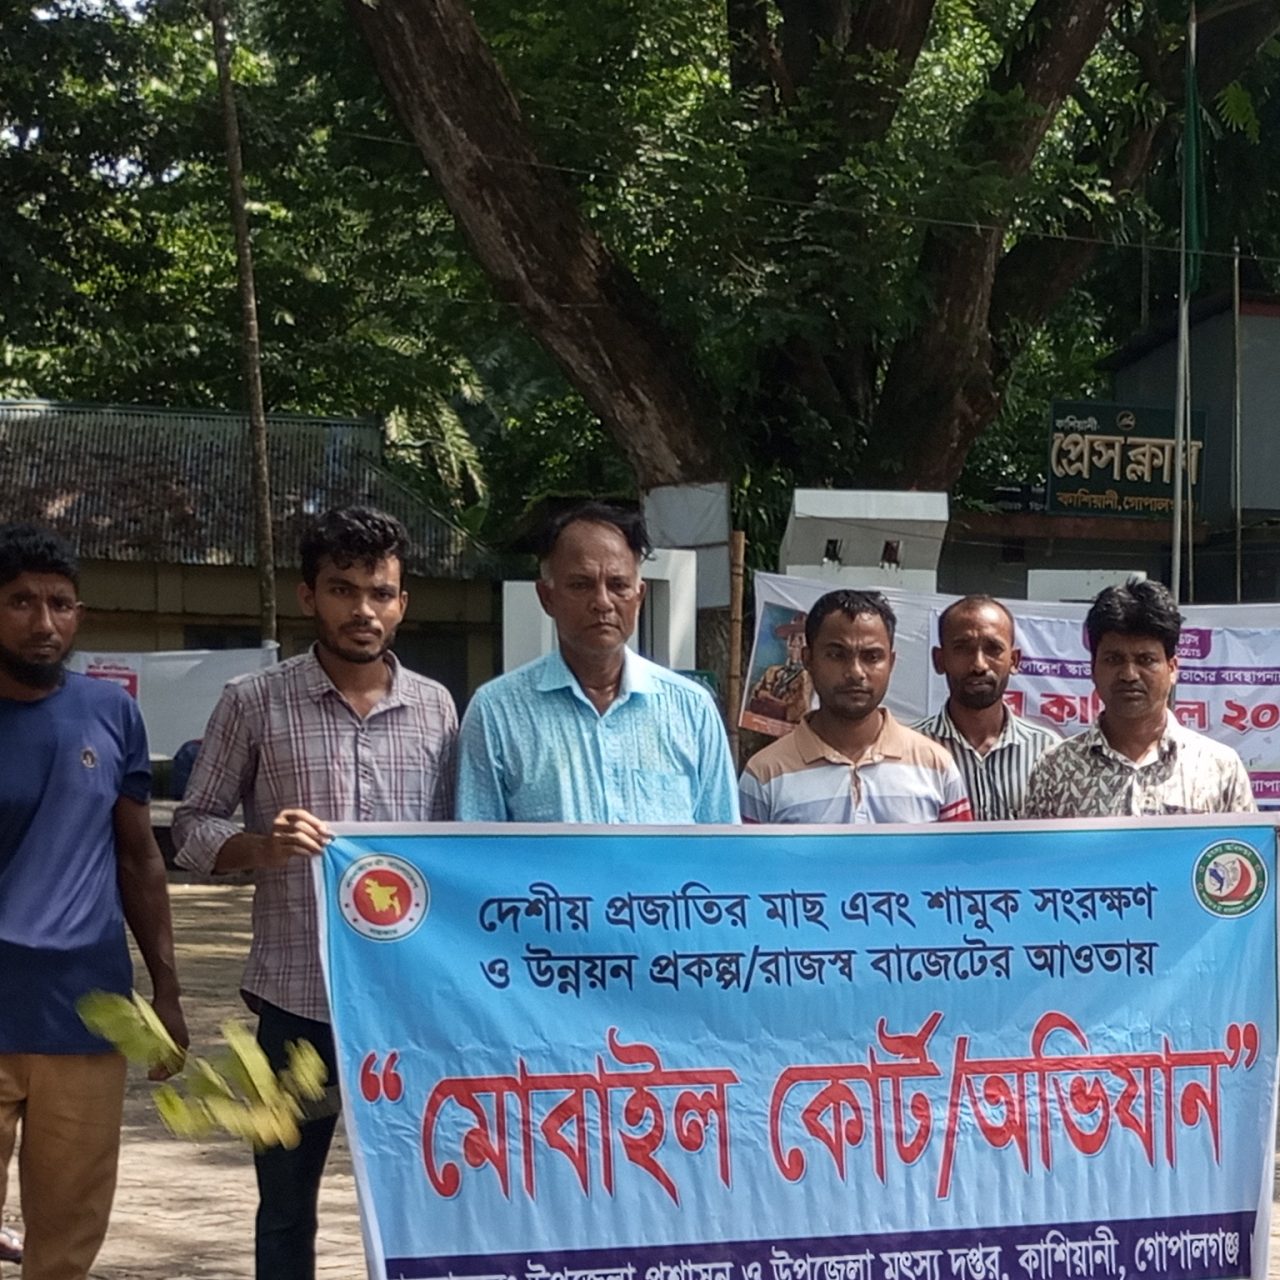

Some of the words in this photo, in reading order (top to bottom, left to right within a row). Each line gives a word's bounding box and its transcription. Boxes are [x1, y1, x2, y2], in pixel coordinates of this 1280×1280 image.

[1051, 432, 1125, 481] প্রেস
[478, 881, 593, 933] দেশীয়
[605, 881, 750, 931] প্রজাতির
[758, 888, 830, 933] মাছ
[840, 889, 915, 928] এবং
[926, 885, 1019, 932] শামুক
[1034, 881, 1159, 924] সংরক্ষণ
[480, 956, 510, 990] ও
[522, 943, 639, 999] উন্নয়ন
[649, 944, 857, 993] প্রকল্প/রাজস্ব
[866, 934, 1014, 985] বাজেটের
[1025, 939, 1160, 979] আওতায়
[1134, 1226, 1240, 1275] গোপালগঞ্জ
